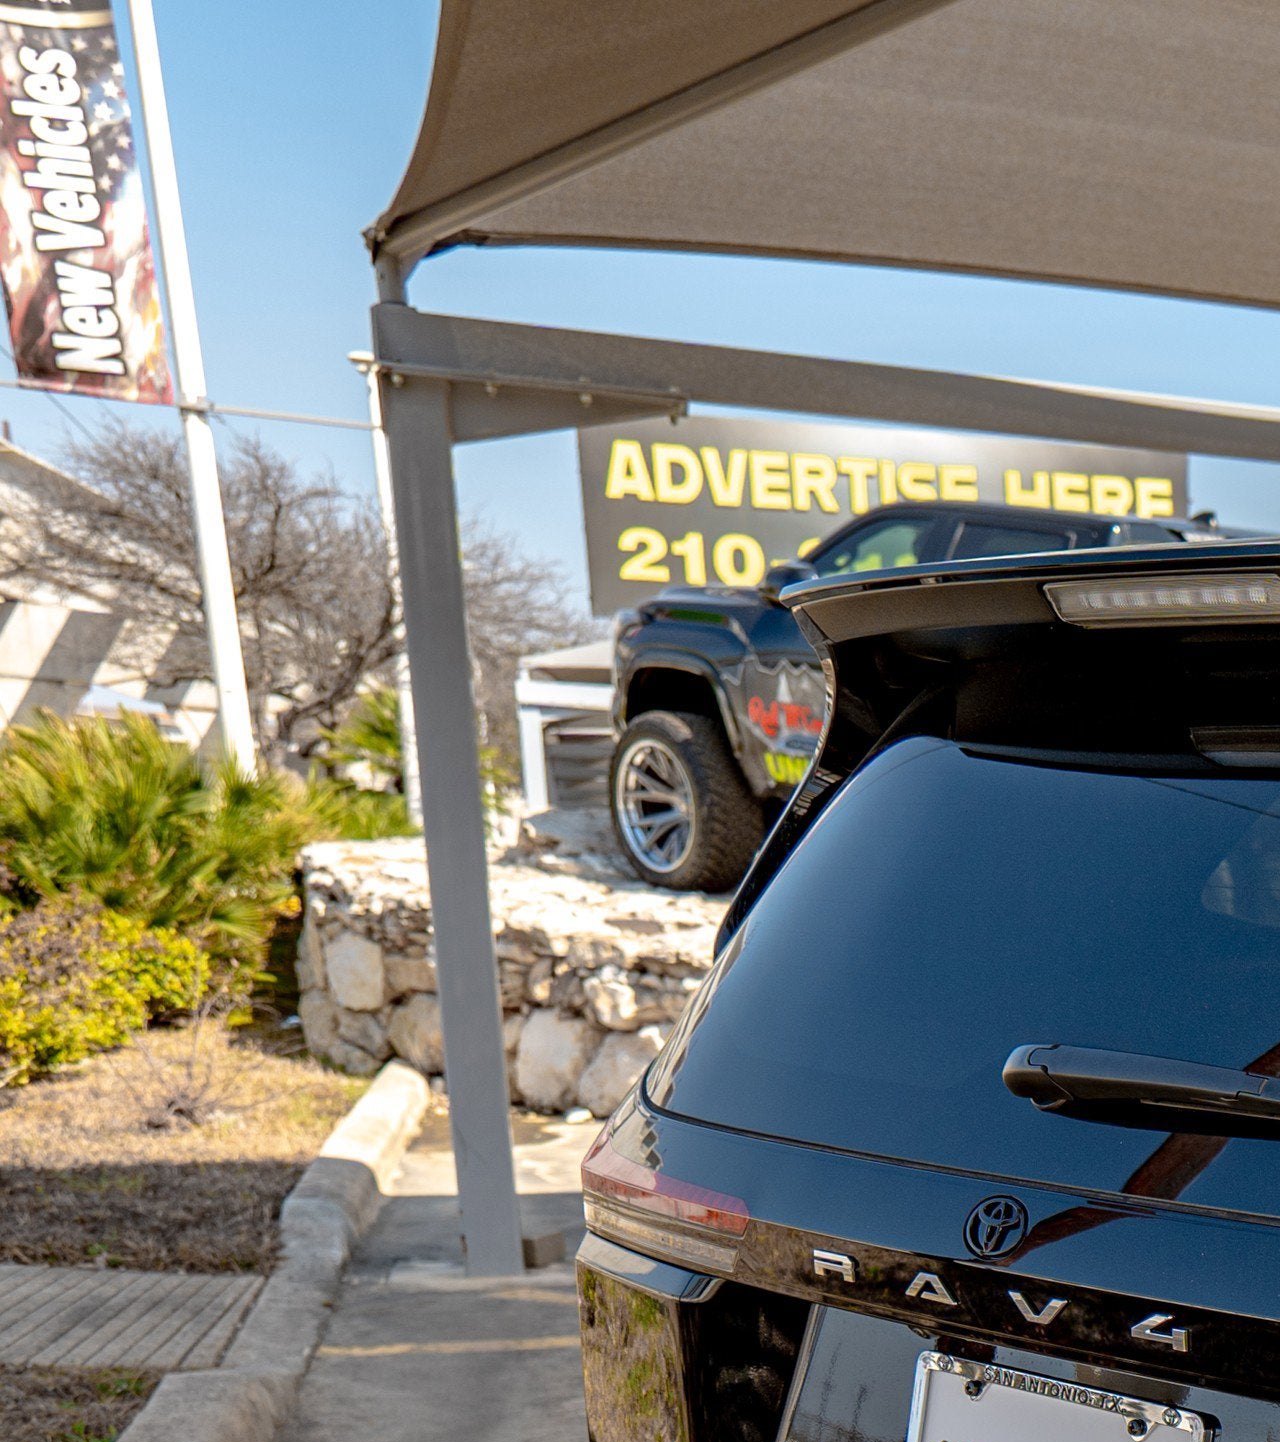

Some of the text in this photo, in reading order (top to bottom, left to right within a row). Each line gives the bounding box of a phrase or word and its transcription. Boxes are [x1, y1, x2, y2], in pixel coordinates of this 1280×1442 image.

[11, 45, 106, 251] Vehicles
[52, 260, 126, 376] New
[605, 439, 1175, 519] ADVERTISE HERE
[812, 1248, 1191, 1353] RAV4
[984, 1366, 1016, 1387] SAN
